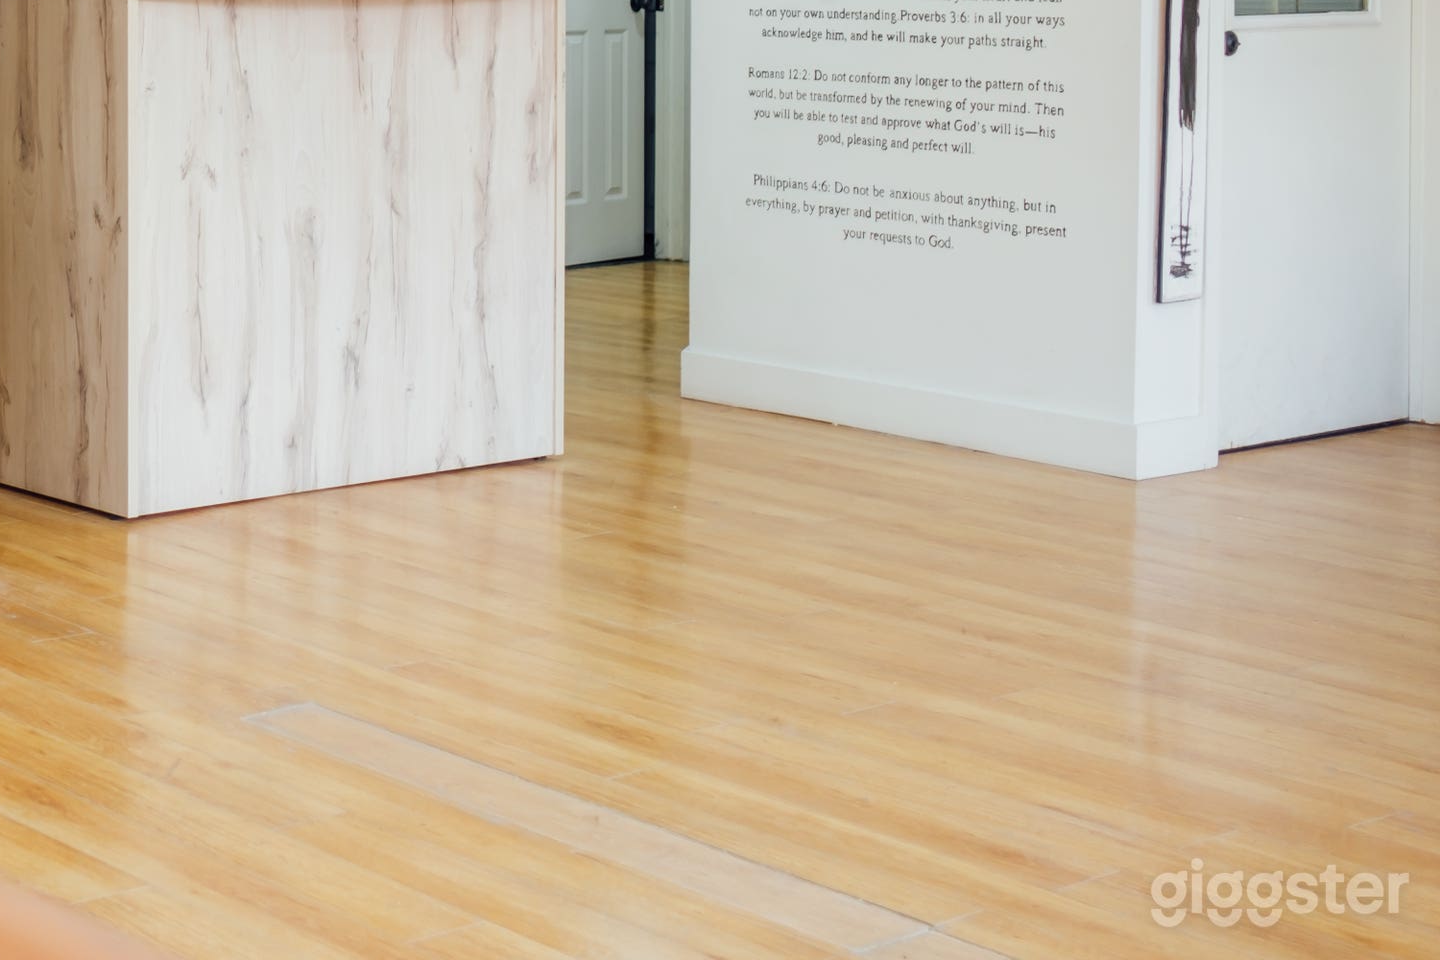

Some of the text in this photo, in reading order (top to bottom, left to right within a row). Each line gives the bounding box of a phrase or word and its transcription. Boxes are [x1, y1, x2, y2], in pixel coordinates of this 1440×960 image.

[748, 7, 763, 17] not
[779, 8, 801, 21] your
[987, 10, 1001, 24] all
[1004, 14, 1032, 27] your
[1035, 15, 1065, 29] ways
[761, 26, 822, 42] acknowledge
[849, 28, 868, 41] and
[885, 30, 905, 43] will
[908, 31, 937, 44] make
[940, 35, 965, 48] your
[967, 33, 997, 49] paths
[747, 66, 1064, 94] Romans not conform any longer the pattern this
[778, 88, 793, 100] but
[809, 90, 867, 104] transformed
[885, 93, 901, 106] the
[903, 97, 952, 112] renewing
[969, 101, 995, 114] your
[1033, 101, 1064, 116] Then
[753, 108, 1011, 135] you will able test and approve what will
[846, 132, 888, 151] pleasing
[888, 137, 909, 149] and
[911, 138, 948, 153] perfect
[753, 173, 808, 192] Philippians
[852, 185, 870, 196] not
[887, 188, 930, 202] anxious
[933, 190, 964, 206] about
[1023, 197, 1041, 212] but
[817, 204, 851, 218] prayer
[852, 205, 871, 219] and
[920, 212, 944, 225] with
[1024, 224, 1066, 238] present
[842, 228, 866, 240] your
[869, 231, 912, 245] requests
